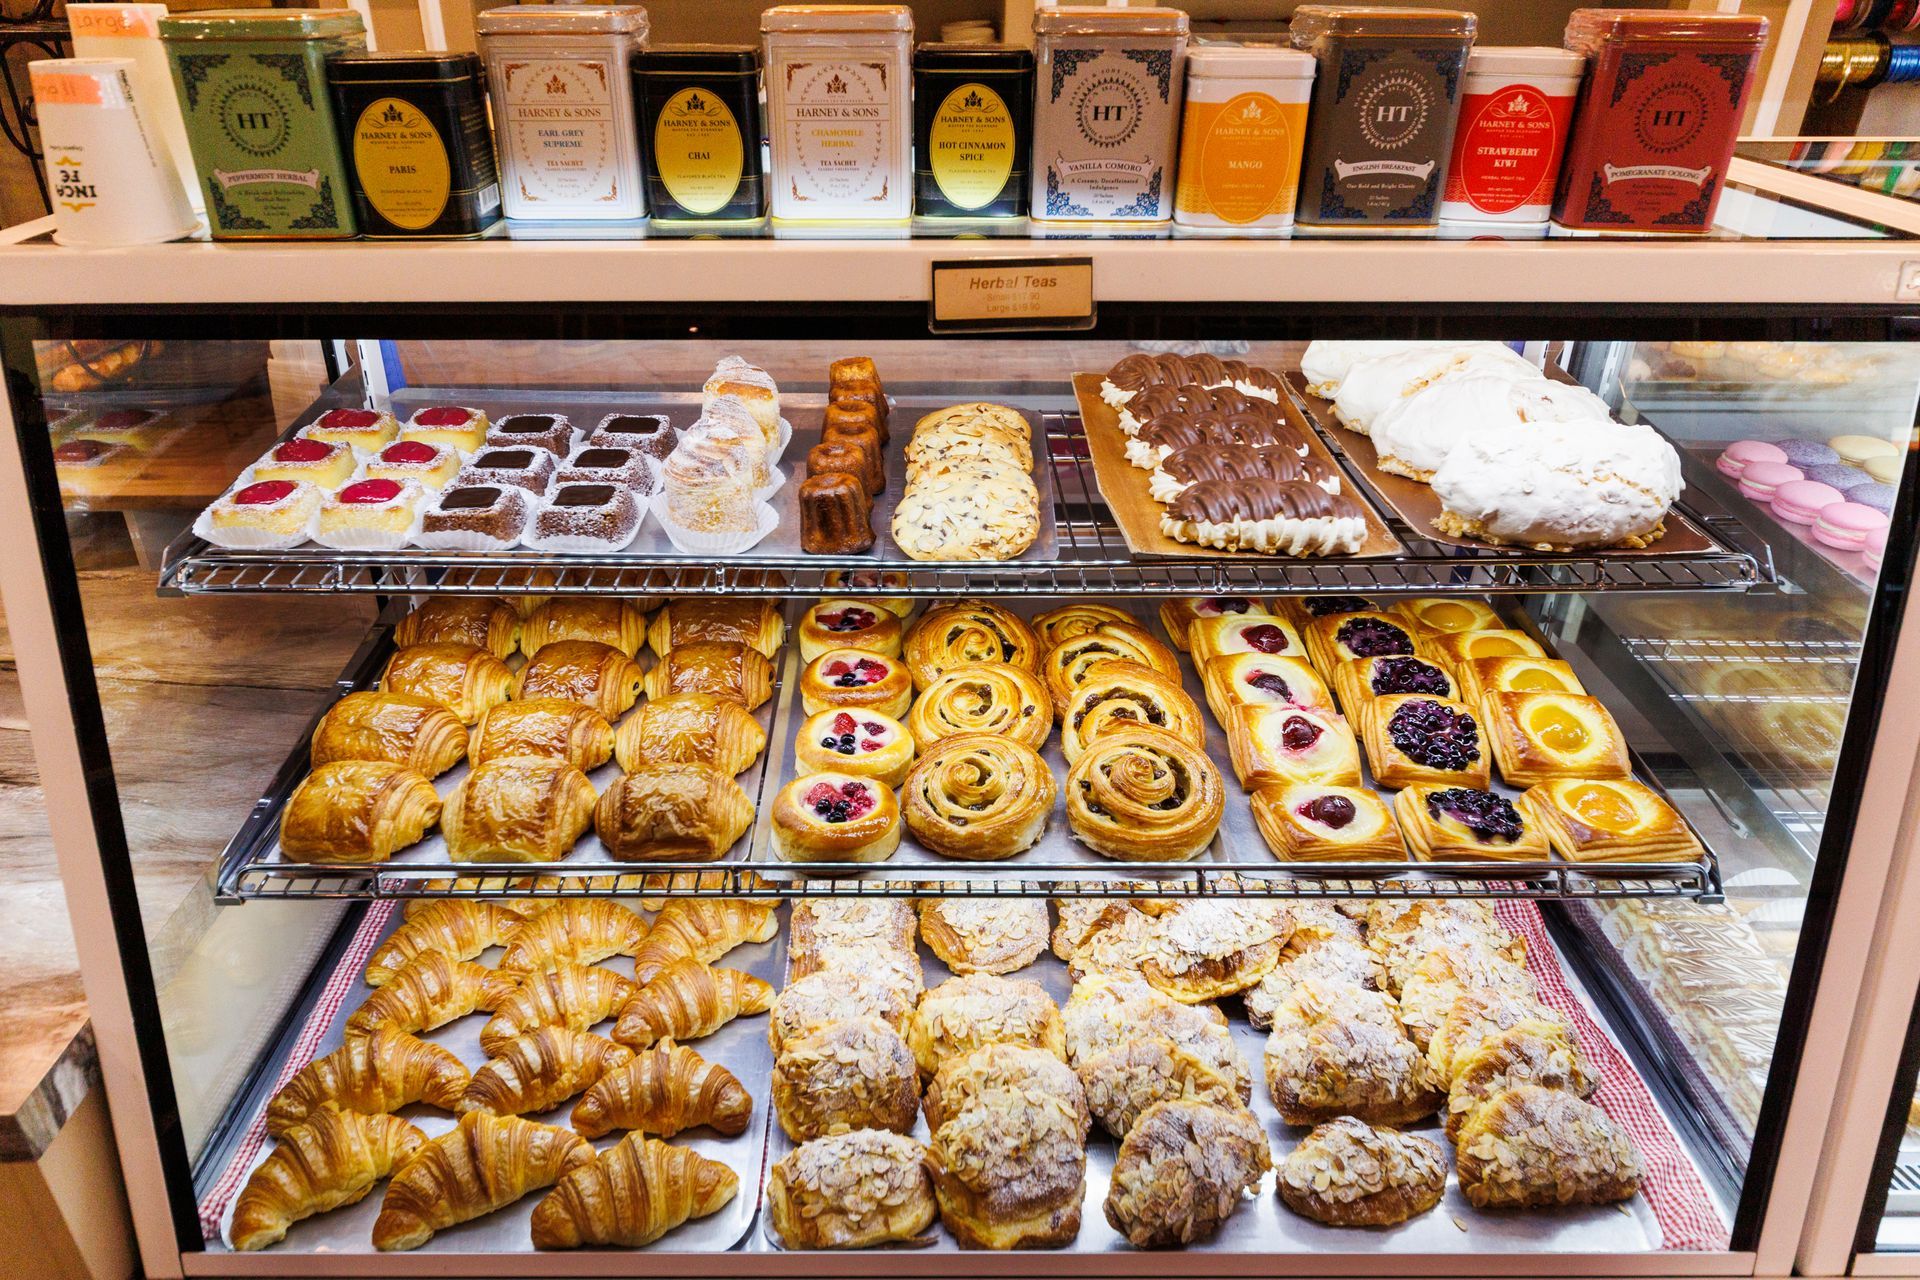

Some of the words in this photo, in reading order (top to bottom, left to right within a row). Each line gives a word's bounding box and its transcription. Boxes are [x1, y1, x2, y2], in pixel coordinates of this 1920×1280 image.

[518, 108, 562, 118] HARNEY
[563, 109, 572, 117] &
[574, 108, 601, 117] SONS
[796, 108, 838, 117] HARNEY
[841, 108, 850, 117] &
[852, 108, 879, 117] SONS
[1093, 105, 1128, 121] HT
[1376, 106, 1413, 122] HT
[236, 112, 273, 130] HT
[1653, 110, 1692, 126] HT
[1479, 120, 1516, 128] HARNEY
[1527, 121, 1551, 129] SONS
[361, 131, 398, 140] HARNEY
[409, 131, 433, 139] SONS
[538, 129, 560, 137] EARL
[561, 129, 585, 137] GREY
[811, 129, 864, 137] CHAMOMILE
[543, 140, 583, 148] SUPREME
[821, 140, 856, 148] HERBAL
[958, 142, 1006, 150] CINNAMON
[688, 152, 710, 160] CHAI
[1477, 147, 1539, 156] STRAWBERRY
[1069, 162, 1102, 171] VANILLA
[1105, 162, 1142, 172] COMORO
[1228, 161, 1263, 169] MANGO
[1353, 164, 1380, 172] ENGLISH
[1381, 163, 1416, 172] BREAKFAST
[1494, 159, 1518, 168] KIWI
[389, 165, 417, 174] PARIS
[1611, 169, 1666, 178] POMEGRANATE
[1667, 170, 1700, 179] OOLONG
[227, 172, 274, 183] PEPPERMINT
[276, 173, 308, 182] HERBAL
[969, 276, 1019, 290] Herbal
[1023, 275, 1058, 288] Teas
